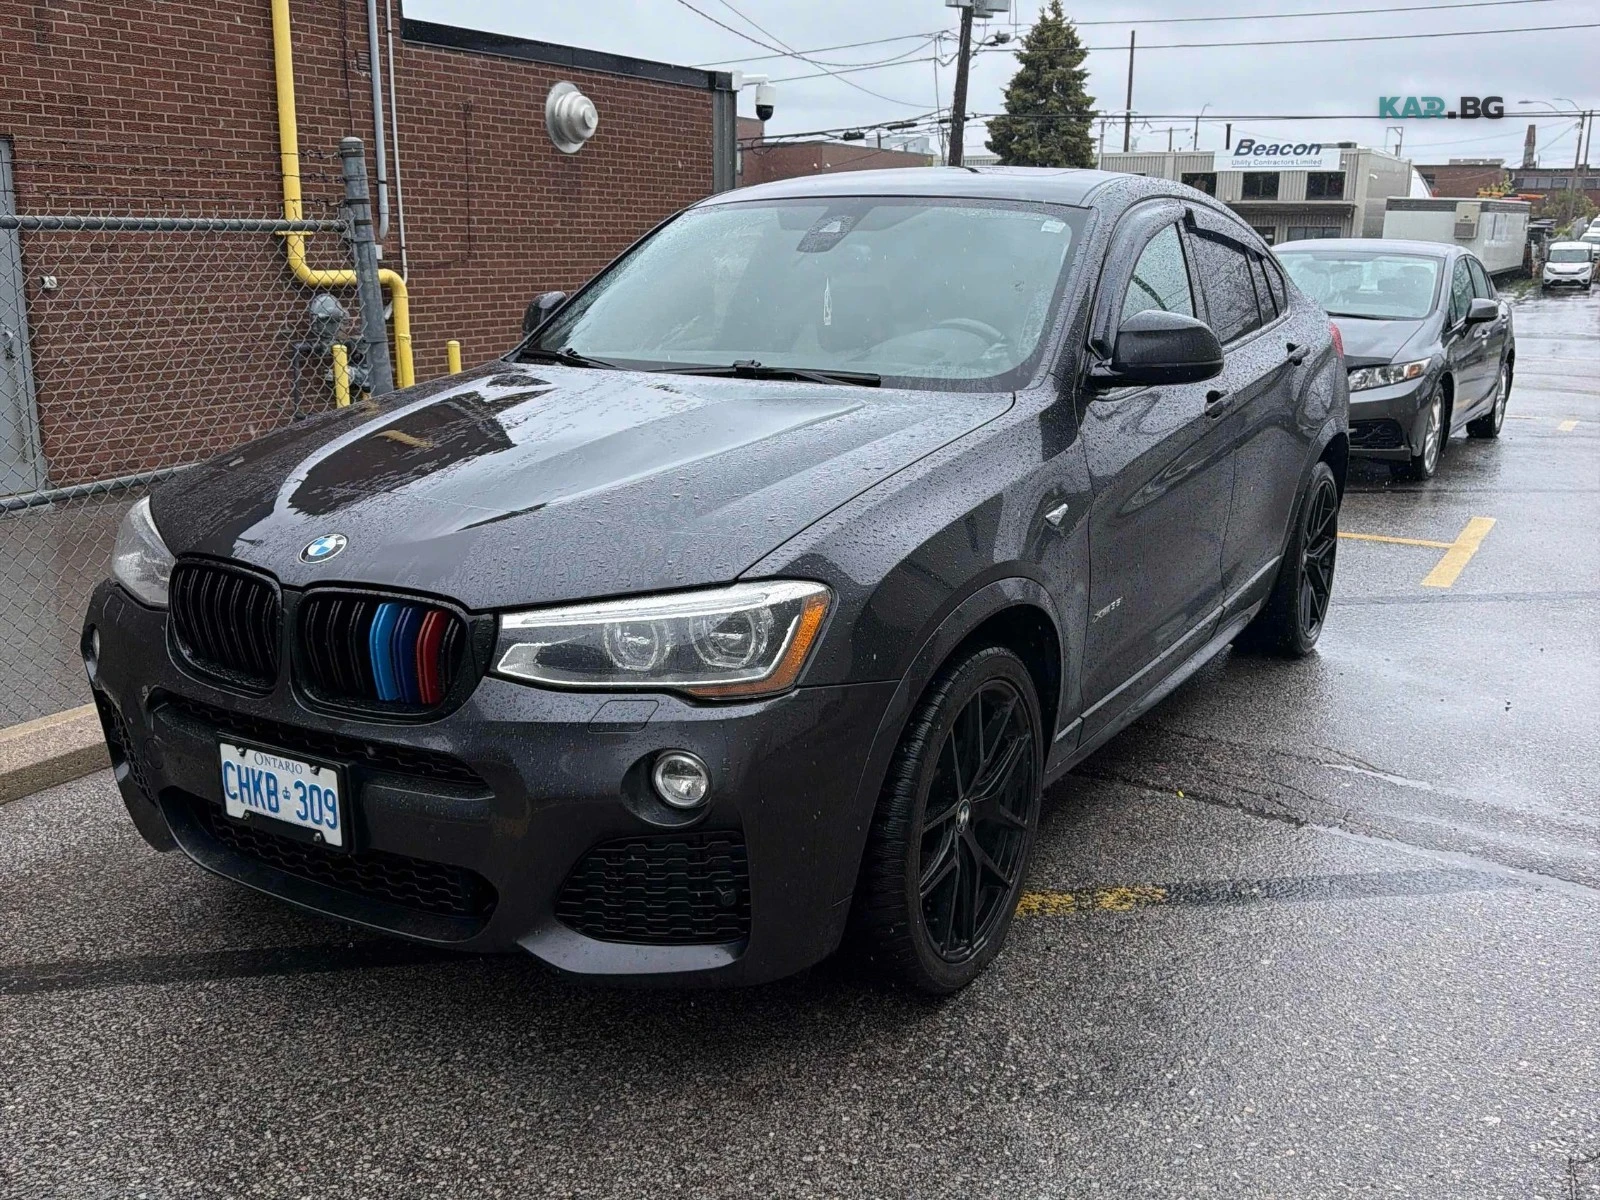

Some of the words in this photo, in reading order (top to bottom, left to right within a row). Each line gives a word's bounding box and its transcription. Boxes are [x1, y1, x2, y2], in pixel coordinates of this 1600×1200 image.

[1233, 138, 1322, 156] Beacon
[1231, 159, 1251, 167] Utility
[1253, 158, 1295, 166] Contractors
[1296, 158, 1322, 166] Limited
[254, 752, 303, 775] ONTARIO
[223, 760, 280, 813] CHKB
[294, 779, 338, 830] 309
